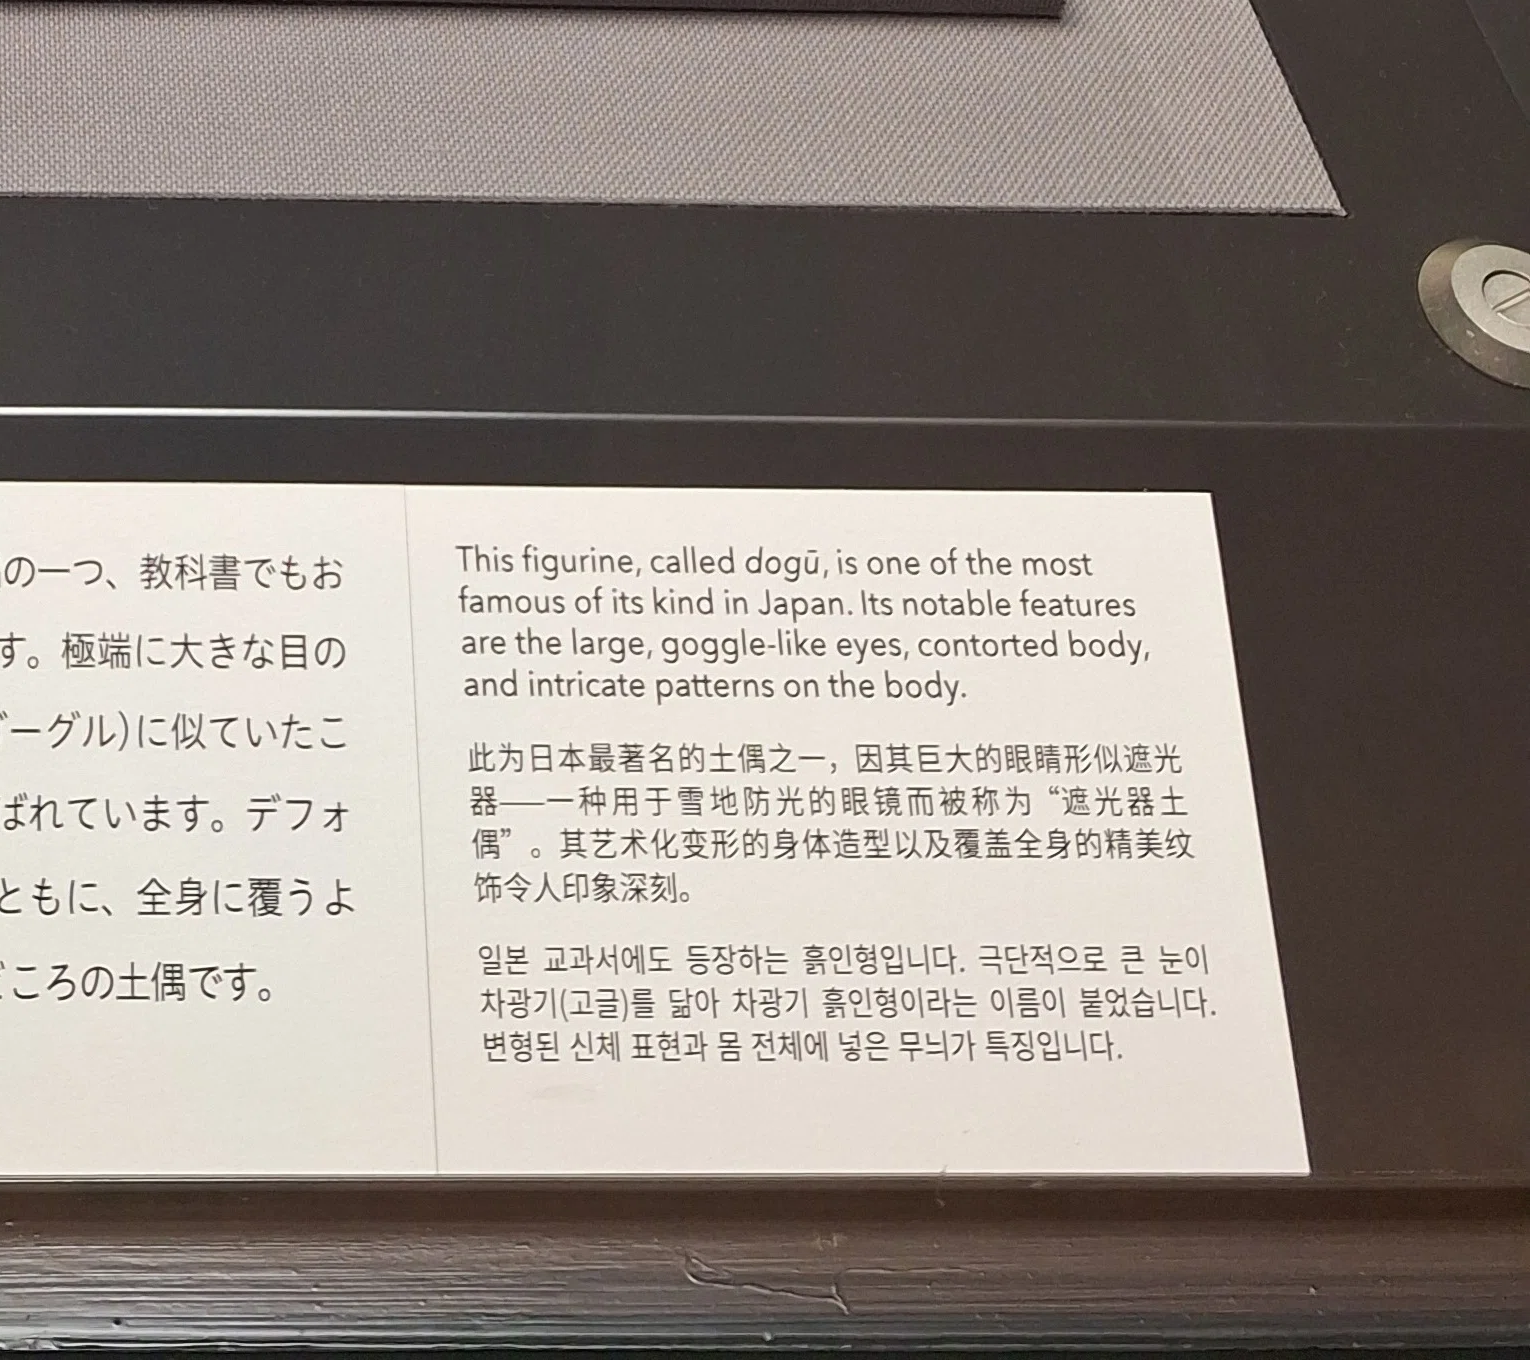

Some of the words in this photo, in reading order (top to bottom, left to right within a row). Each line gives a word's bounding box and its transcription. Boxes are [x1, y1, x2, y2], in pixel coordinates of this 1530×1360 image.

[454, 543, 514, 573] This
[521, 543, 642, 581] figurine,
[649, 545, 736, 575] called
[744, 545, 829, 583] dogū,
[836, 548, 858, 576] is
[866, 556, 921, 576] one
[929, 546, 958, 576] of
[964, 547, 1013, 576] the
[1021, 553, 1094, 577] most
[457, 584, 566, 615] famous
[574, 585, 604, 615] of
[611, 587, 644, 615] its
[652, 585, 715, 616] kind
[723, 588, 749, 615] in
[757, 588, 854, 624] Japan.
[860, 589, 894, 617] Its
[902, 588, 1012, 617] notable
[1018, 588, 1136, 618] features
[461, 635, 507, 655] are
[514, 626, 563, 656] the
[571, 626, 653, 664] large,
[661, 627, 827, 665] goggle-like
[836, 637, 910, 665] eyes,
[917, 629, 1059, 658] contorted
[1067, 629, 1150, 666] body,
[463, 667, 519, 698] and
[528, 669, 646, 698] intricate
[655, 673, 775, 706] patterns
[783, 678, 820, 698] on
[827, 669, 875, 699] the
[883, 669, 967, 707] body.
[478, 944, 530, 976] 일본
[543, 943, 674, 976] 교과서에도
[685, 943, 789, 976] 등장하는
[802, 943, 966, 976] 흙인형입니다.
[978, 943, 1108, 976] 극단적으로
[1120, 945, 1146, 975] 큰
[1158, 943, 1209, 975] 눈이
[480, 987, 656, 1023] 차광기(고글)를
[668, 986, 721, 1020] 닮아
[731, 987, 809, 1019] 차광기
[821, 986, 978, 1019] 흙인형이라는
[990, 986, 1066, 1019] 이름이
[1079, 986, 1217, 1019] 붙었습니다.
[483, 1030, 561, 1063] 변형된
[570, 1030, 621, 1063] 신체
[630, 1030, 709, 1063] 표현과
[716, 1031, 743, 1062] 몸
[751, 1030, 829, 1063] 전체에
[838, 1029, 890, 1062] 넣은
[898, 1029, 977, 1063] 무늬가
[985, 1029, 1123, 1062] 특징입니다.
